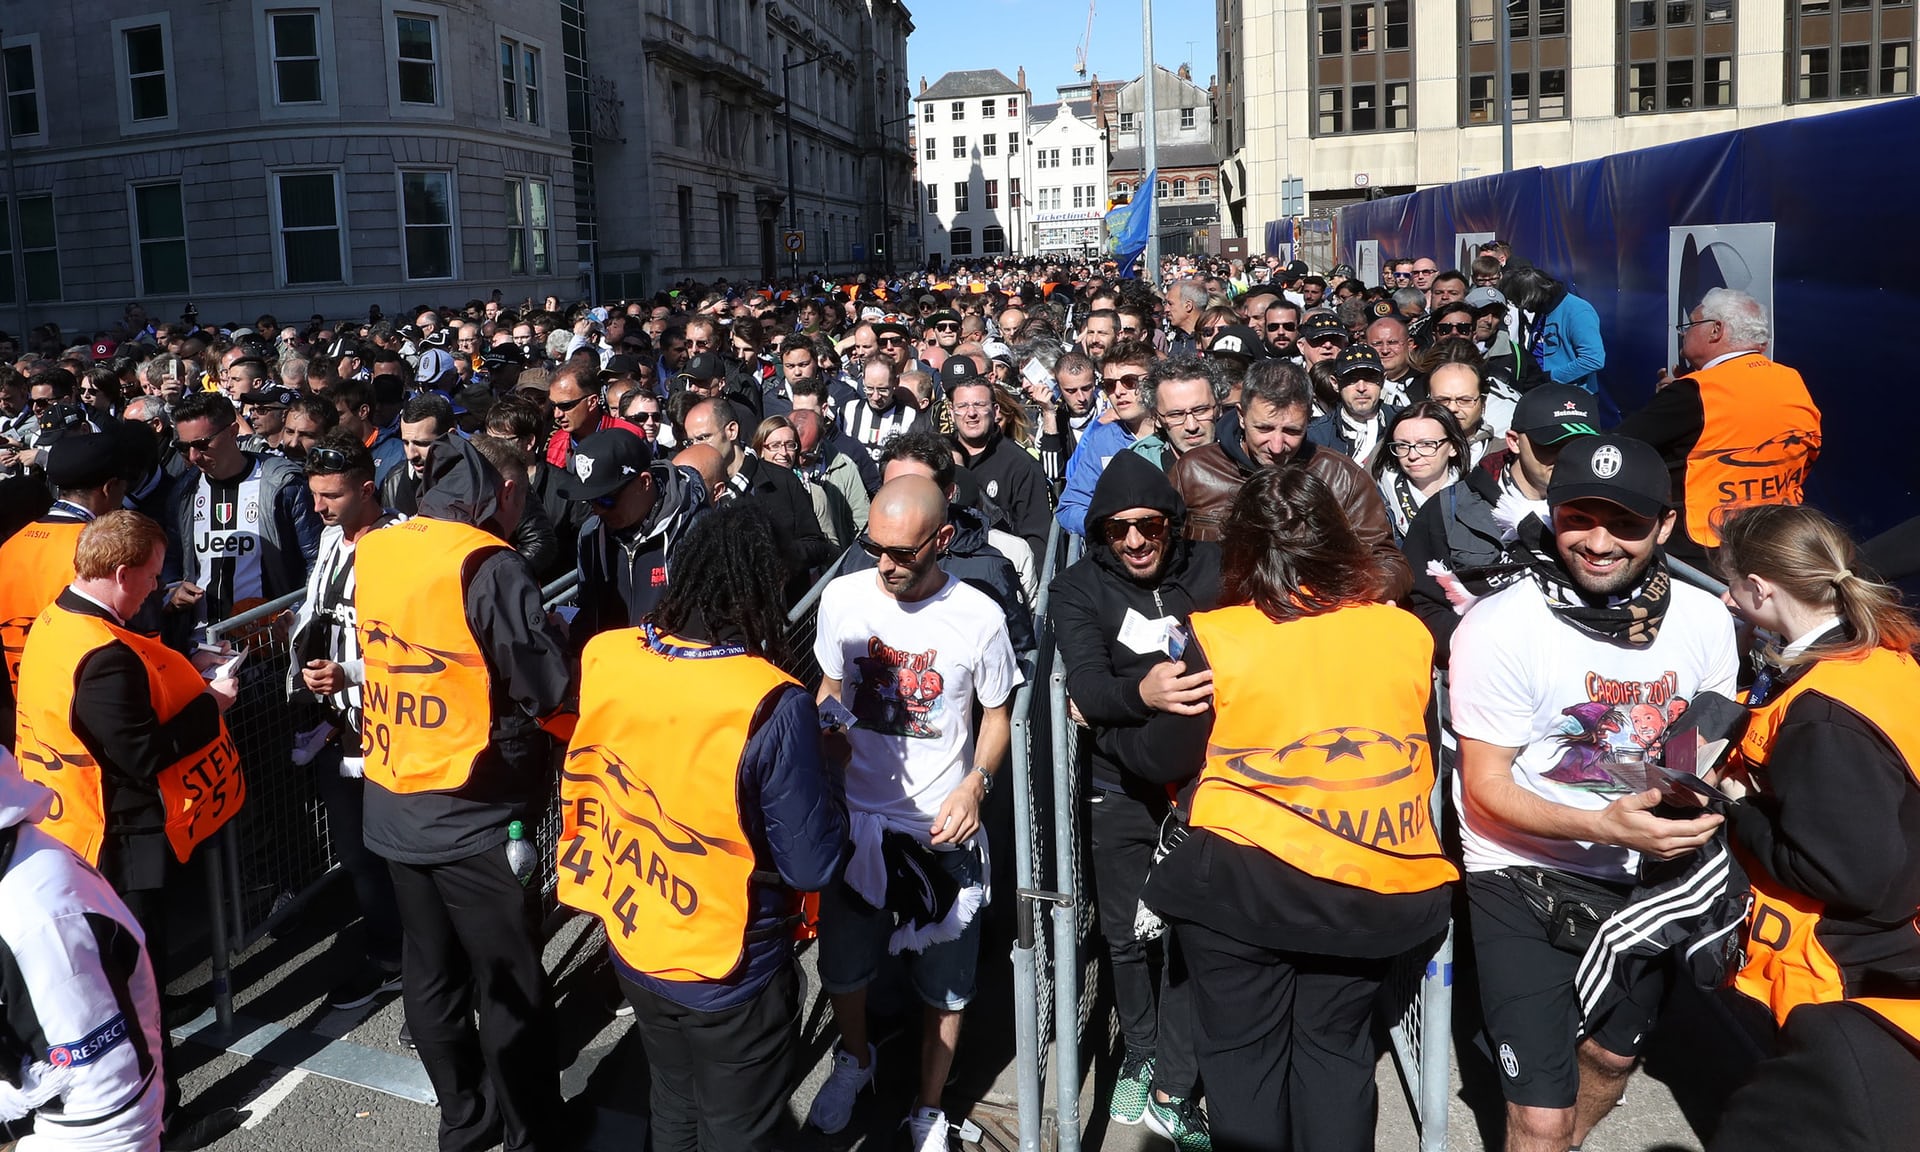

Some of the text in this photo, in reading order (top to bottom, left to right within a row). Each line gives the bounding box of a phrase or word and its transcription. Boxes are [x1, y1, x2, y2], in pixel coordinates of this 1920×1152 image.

[196, 532, 255, 556] Jeep
[1585, 671, 1677, 706] CARDIFF 2017
[71, 1018, 126, 1061] RESPECT
